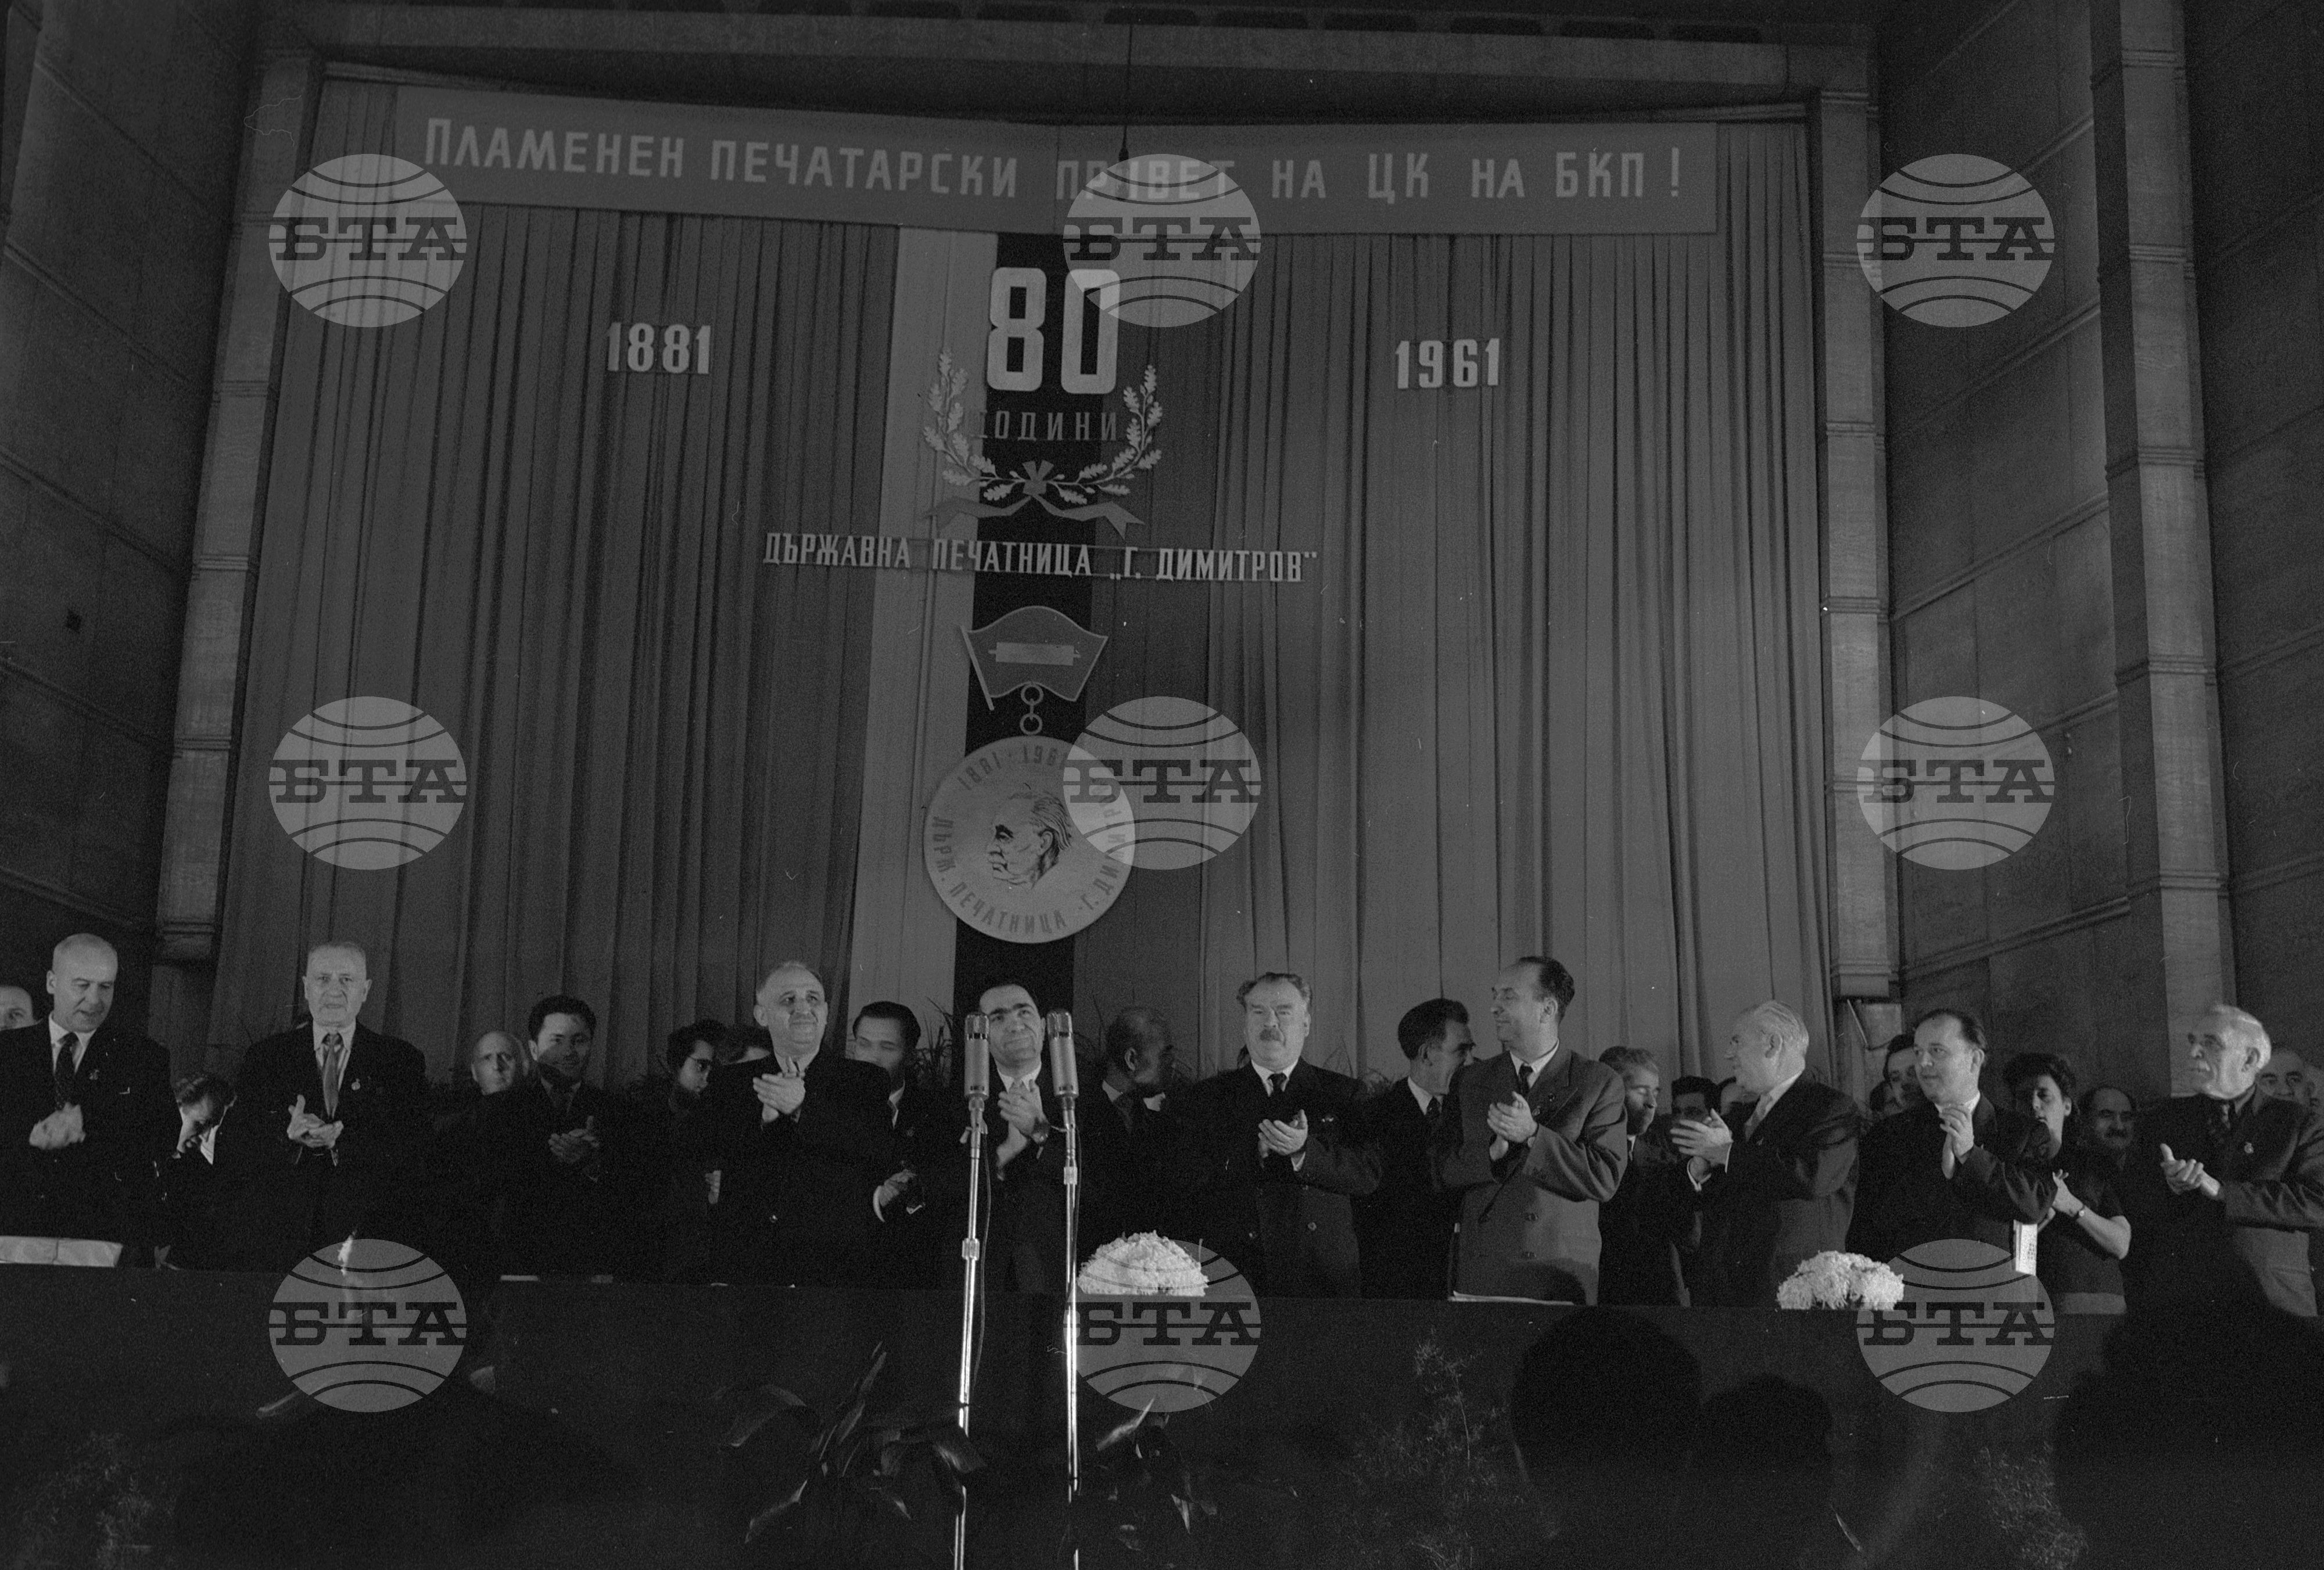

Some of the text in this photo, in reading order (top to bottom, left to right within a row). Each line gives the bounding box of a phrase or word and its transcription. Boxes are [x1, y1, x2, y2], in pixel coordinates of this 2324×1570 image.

[425, 118, 684, 178] ПЛАМЕНЕН
[709, 139, 1017, 198] ПЕЧАТАРСКИ
[1272, 159, 1326, 198] НА
[1368, 153, 1429, 204] ЦК
[1471, 159, 1525, 198] НА
[607, 322, 712, 374] 1881
[987, 267, 1121, 394] 80
[1395, 338, 1500, 389] 1961
[763, 532, 910, 568] ДЪРЖАВНА
[933, 538, 1091, 578] ПЕЧАТНИЦА
[957, 752, 1002, 791] 1881
[949, 881, 1067, 934] ПЕЧАТНИЦА
